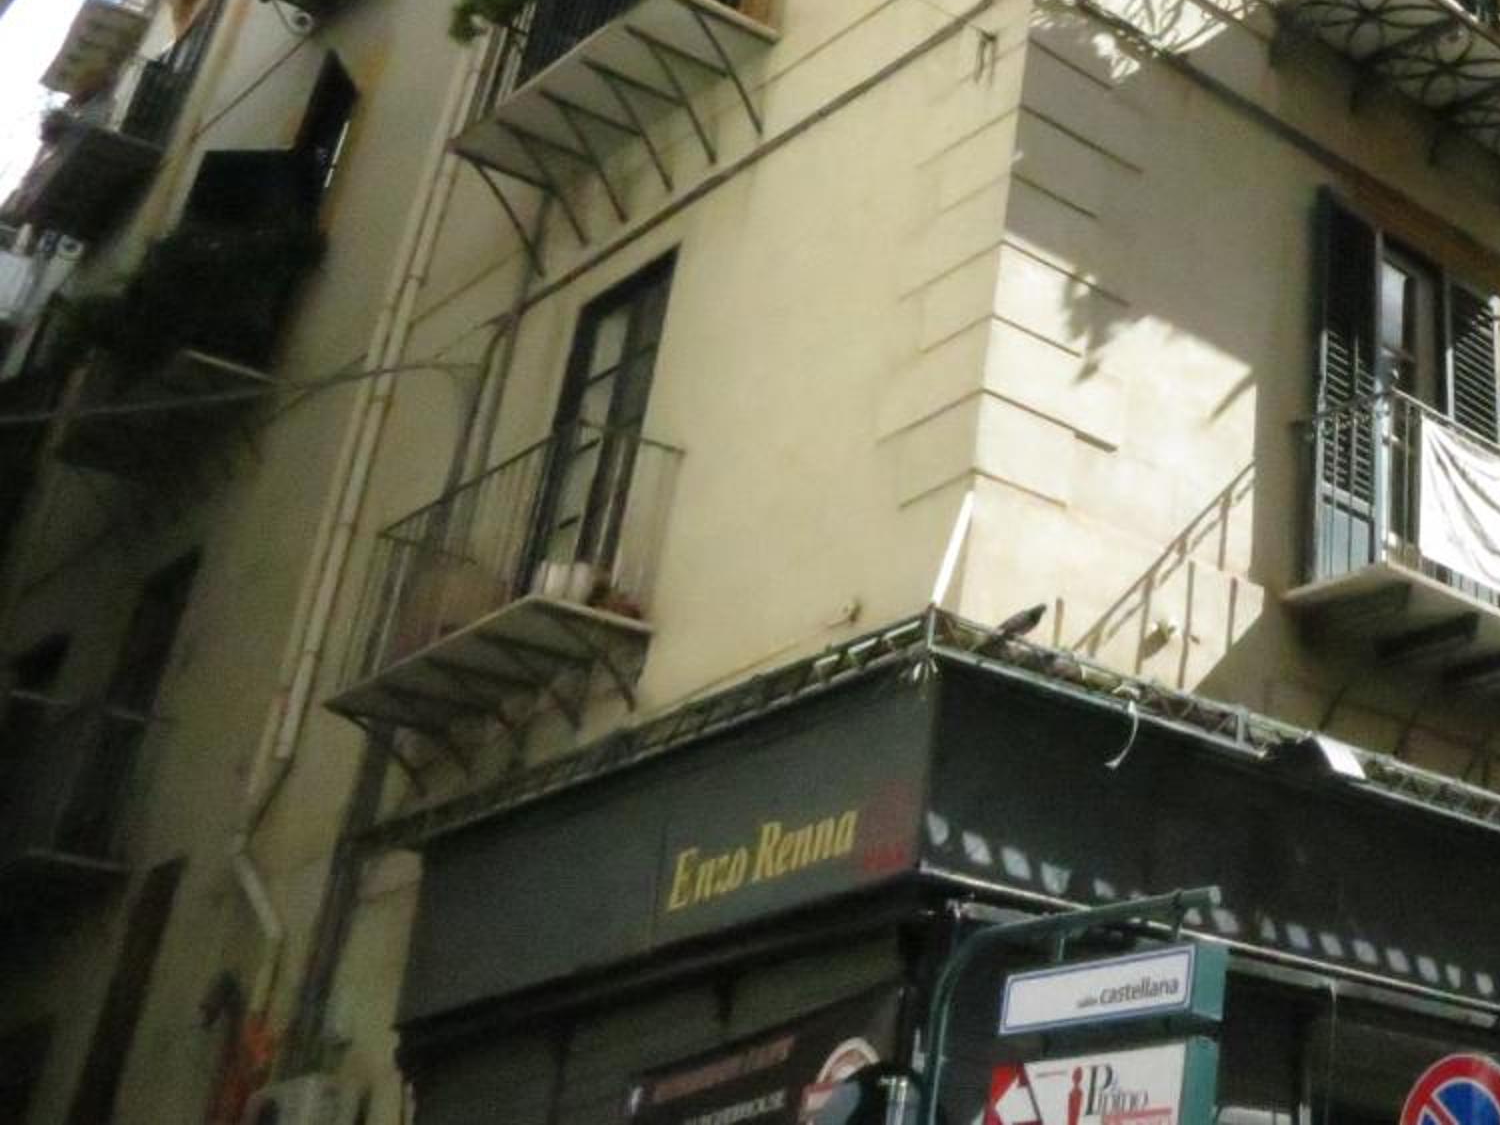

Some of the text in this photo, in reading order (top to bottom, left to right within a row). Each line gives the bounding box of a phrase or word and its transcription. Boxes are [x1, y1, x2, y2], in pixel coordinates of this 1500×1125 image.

[667, 810, 859, 912] Enzo Renna
[1100, 976, 1180, 1004] castellana
